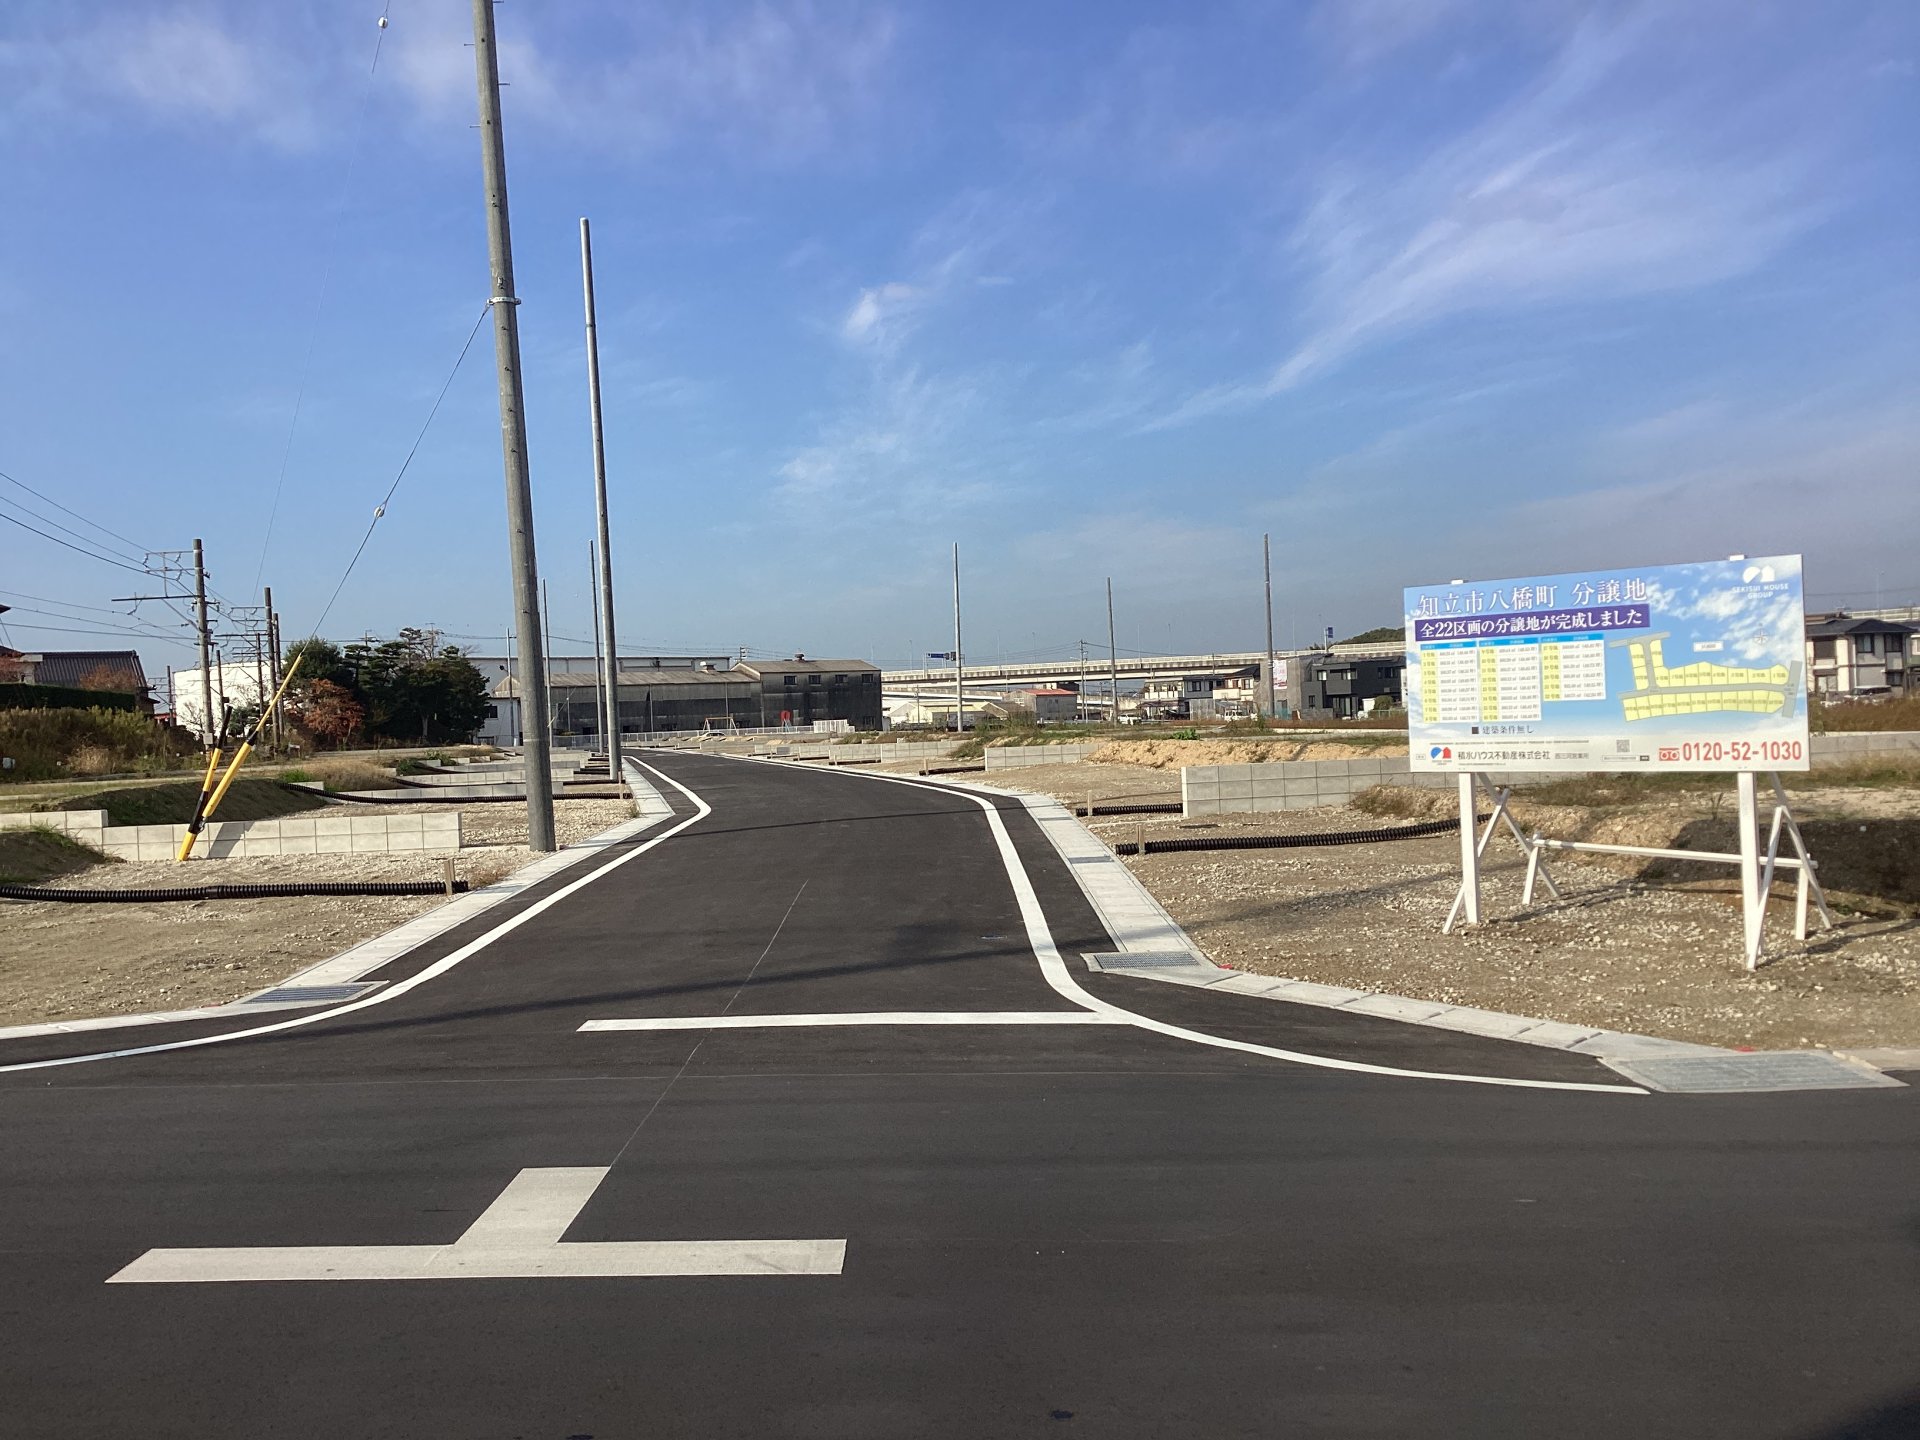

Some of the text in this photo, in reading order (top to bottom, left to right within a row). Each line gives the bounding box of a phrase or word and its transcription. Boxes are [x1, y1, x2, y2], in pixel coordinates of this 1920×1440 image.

[1418, 577, 1648, 617] 知立市八橋町 分譲地
[1420, 608, 1643, 639] 全22区画の分譲地が完成しました
[1457, 750, 1551, 761] 積水ハウス不動産株式会社
[1682, 740, 1802, 762] 0120-52-1030
